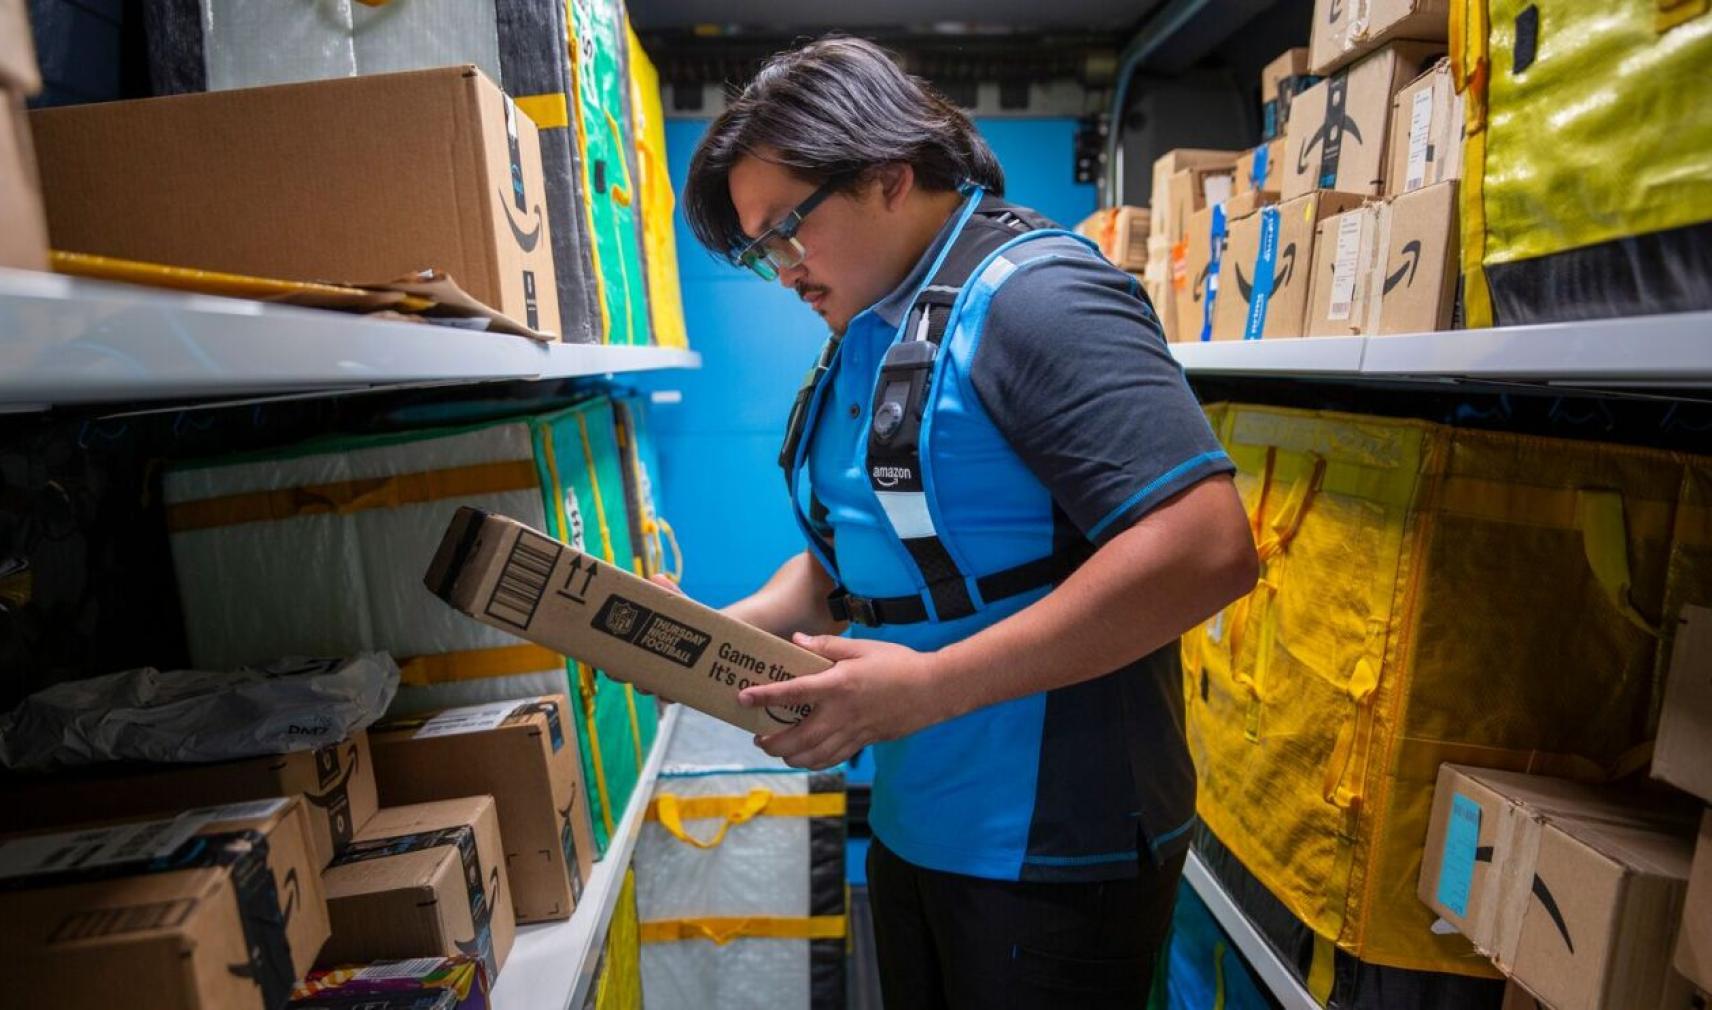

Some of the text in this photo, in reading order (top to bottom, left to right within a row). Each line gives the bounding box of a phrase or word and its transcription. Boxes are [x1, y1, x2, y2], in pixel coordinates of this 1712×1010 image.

[873, 466, 911, 479] amazon
[647, 627, 681, 646] NIGHT
[653, 617, 707, 645] THURSDAY
[640, 635, 692, 662] FOOTBALL
[718, 643, 766, 674] Game
[709, 661, 737, 686] It's
